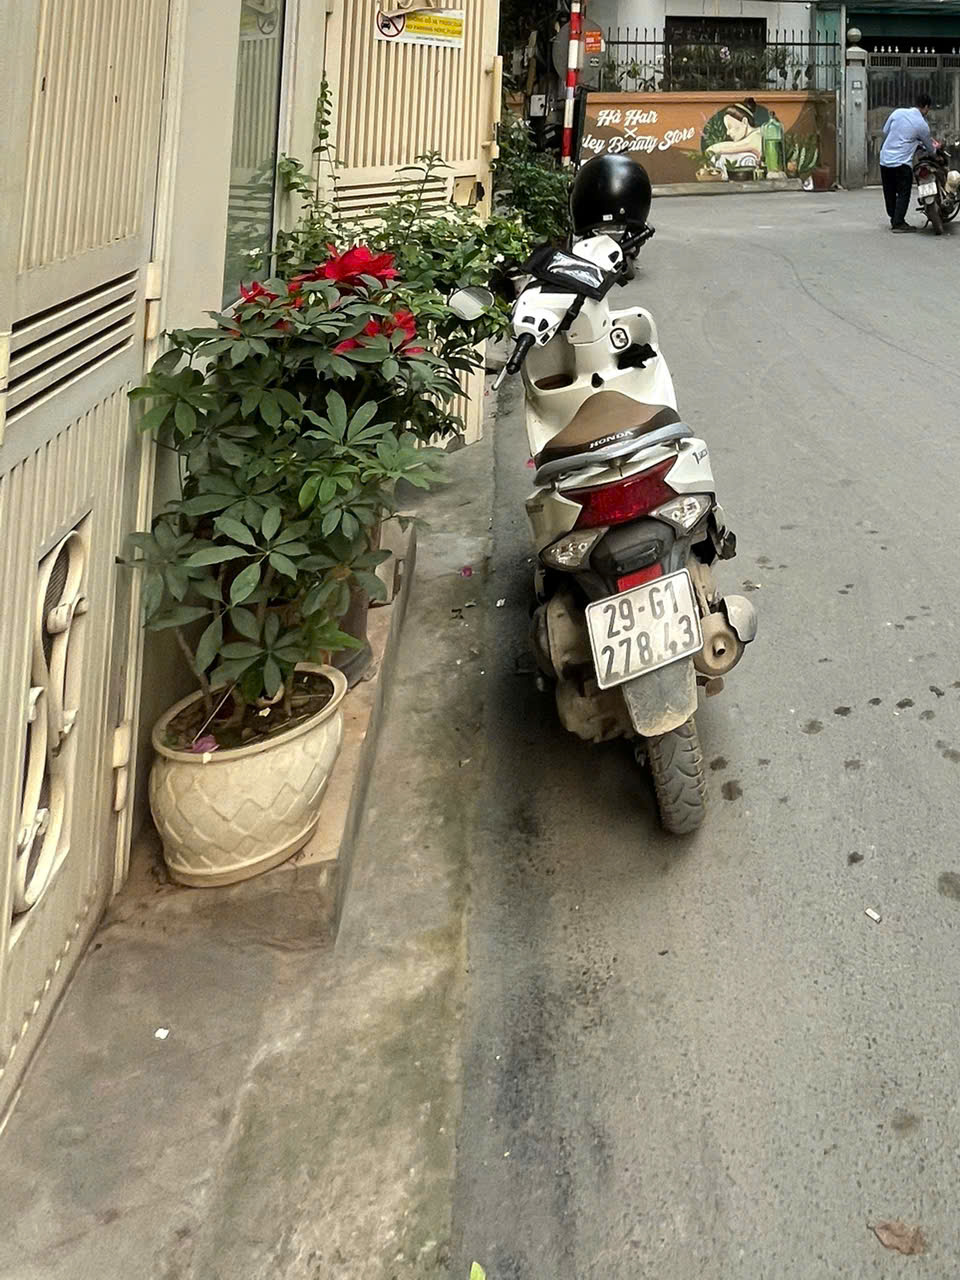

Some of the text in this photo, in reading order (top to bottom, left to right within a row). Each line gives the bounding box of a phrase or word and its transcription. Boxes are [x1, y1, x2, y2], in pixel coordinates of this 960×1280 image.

[596, 109, 658, 127] Hà Hair
[607, 134, 658, 154] Beauty
[658, 127, 695, 151] Store
[589, 430, 634, 449] HONDA
[603, 581, 679, 639] 29-G1
